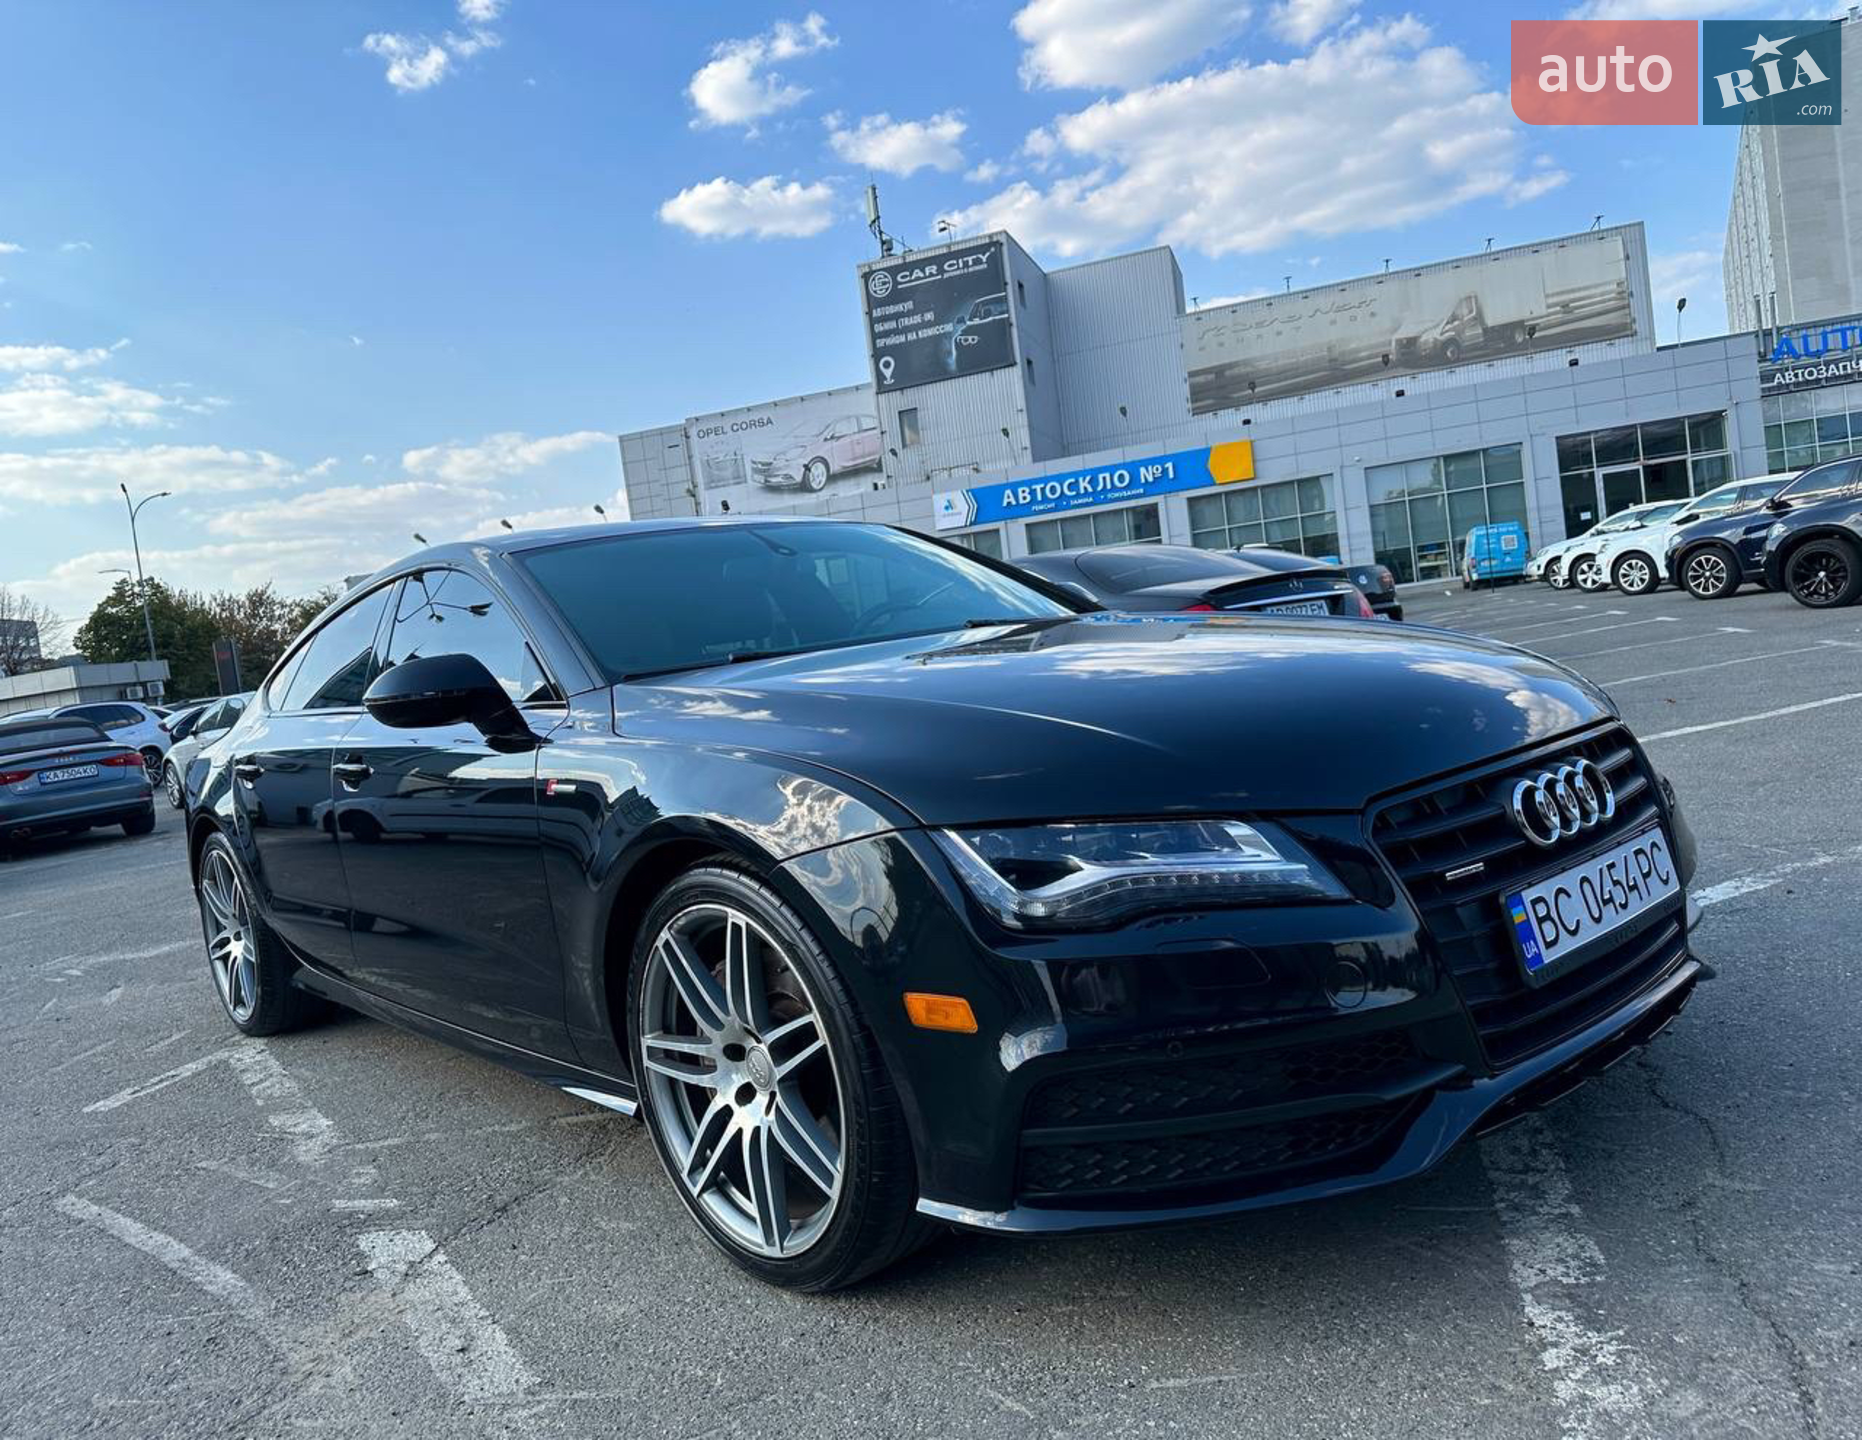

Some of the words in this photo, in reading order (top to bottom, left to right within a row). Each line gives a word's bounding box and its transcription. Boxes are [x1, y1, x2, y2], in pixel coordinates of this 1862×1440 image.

[896, 264, 937, 283] CAR
[943, 252, 990, 271] CITY
[1769, 326, 1862, 364] AUT
[696, 425, 727, 439] OPEL
[731, 416, 774, 433] CORSA
[1002, 469, 1130, 507] АВТОСКЛО
[1139, 461, 1175, 484] №1
[1529, 886, 1580, 950] BC
[1522, 940, 1539, 959] UA
